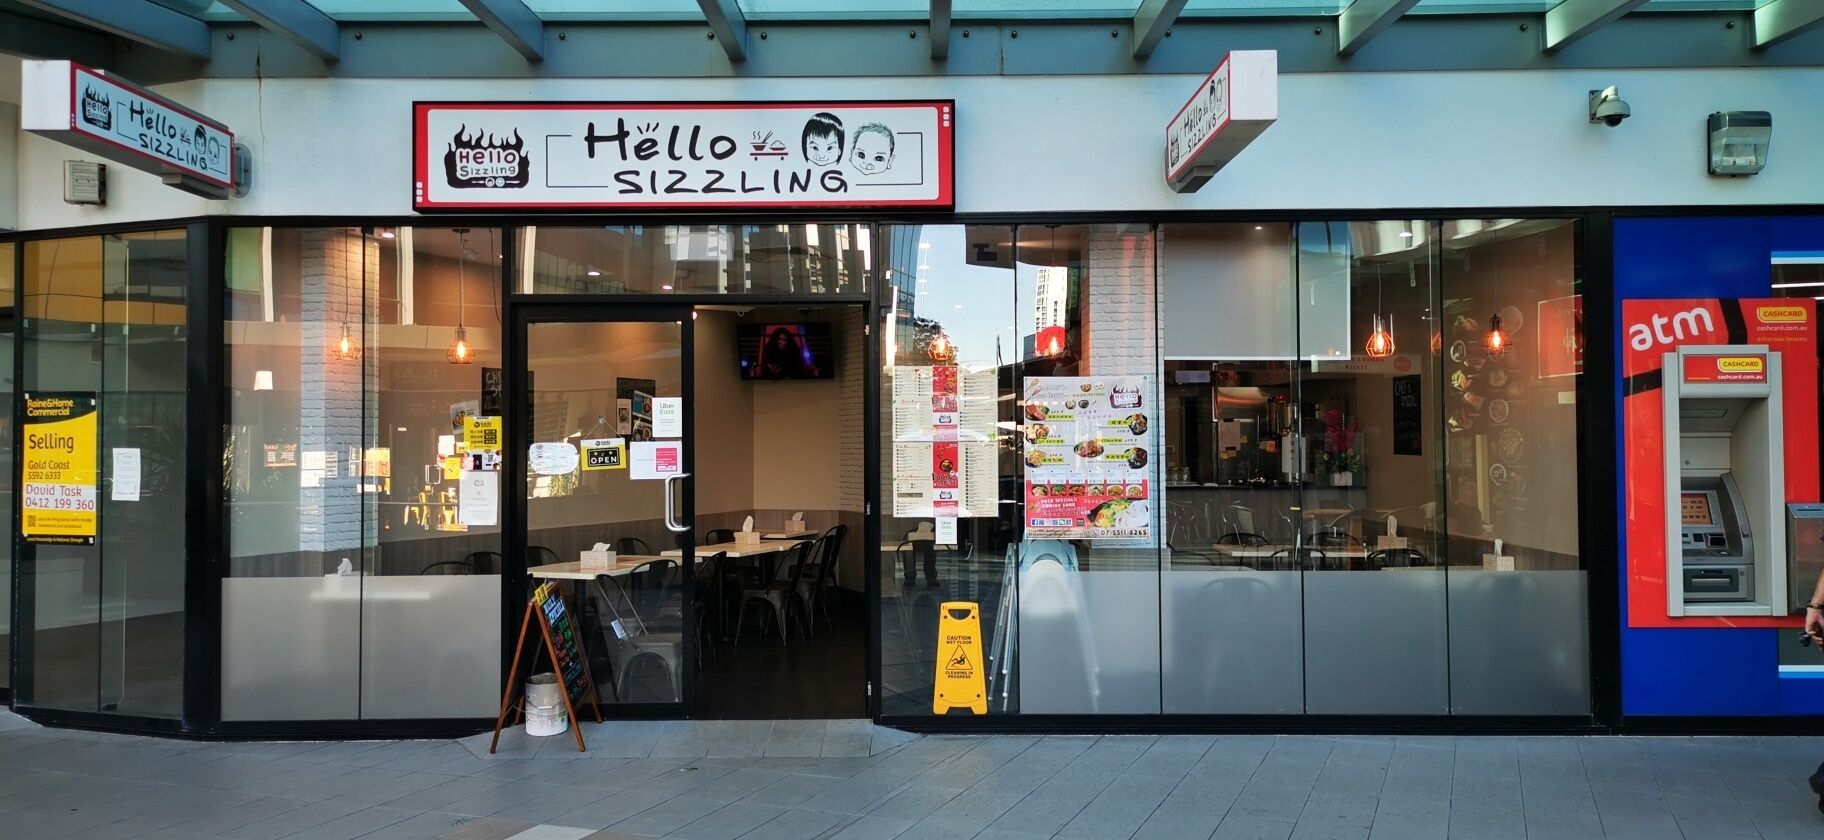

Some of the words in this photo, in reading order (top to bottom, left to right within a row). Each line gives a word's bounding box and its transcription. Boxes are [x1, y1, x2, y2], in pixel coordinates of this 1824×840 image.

[86, 100, 109, 115] Hello
[129, 100, 177, 140] Hello
[1184, 105, 1202, 137] Hello
[584, 117, 738, 161] Hello
[1187, 113, 1217, 153] SIZZLING
[138, 133, 208, 172] SIZZLING
[459, 151, 517, 164] Hello
[459, 165, 516, 177] Sizzling
[613, 168, 848, 195] SIZZLING
[1629, 307, 1714, 351] atm
[27, 399, 74, 408] Raine&Horne
[27, 407, 70, 417] Commercial
[29, 433, 74, 454] Selling
[28, 460, 48, 470] Gold
[48, 460, 70, 470] Coast
[590, 455, 617, 464] OPEN
[27, 471, 44, 480] 5592
[44, 471, 61, 480] 6333
[26, 484, 55, 495] David
[60, 486, 82, 496] Task
[25, 498, 49, 508] 0412
[54, 498, 72, 509] 199
[76, 499, 94, 511] 360
